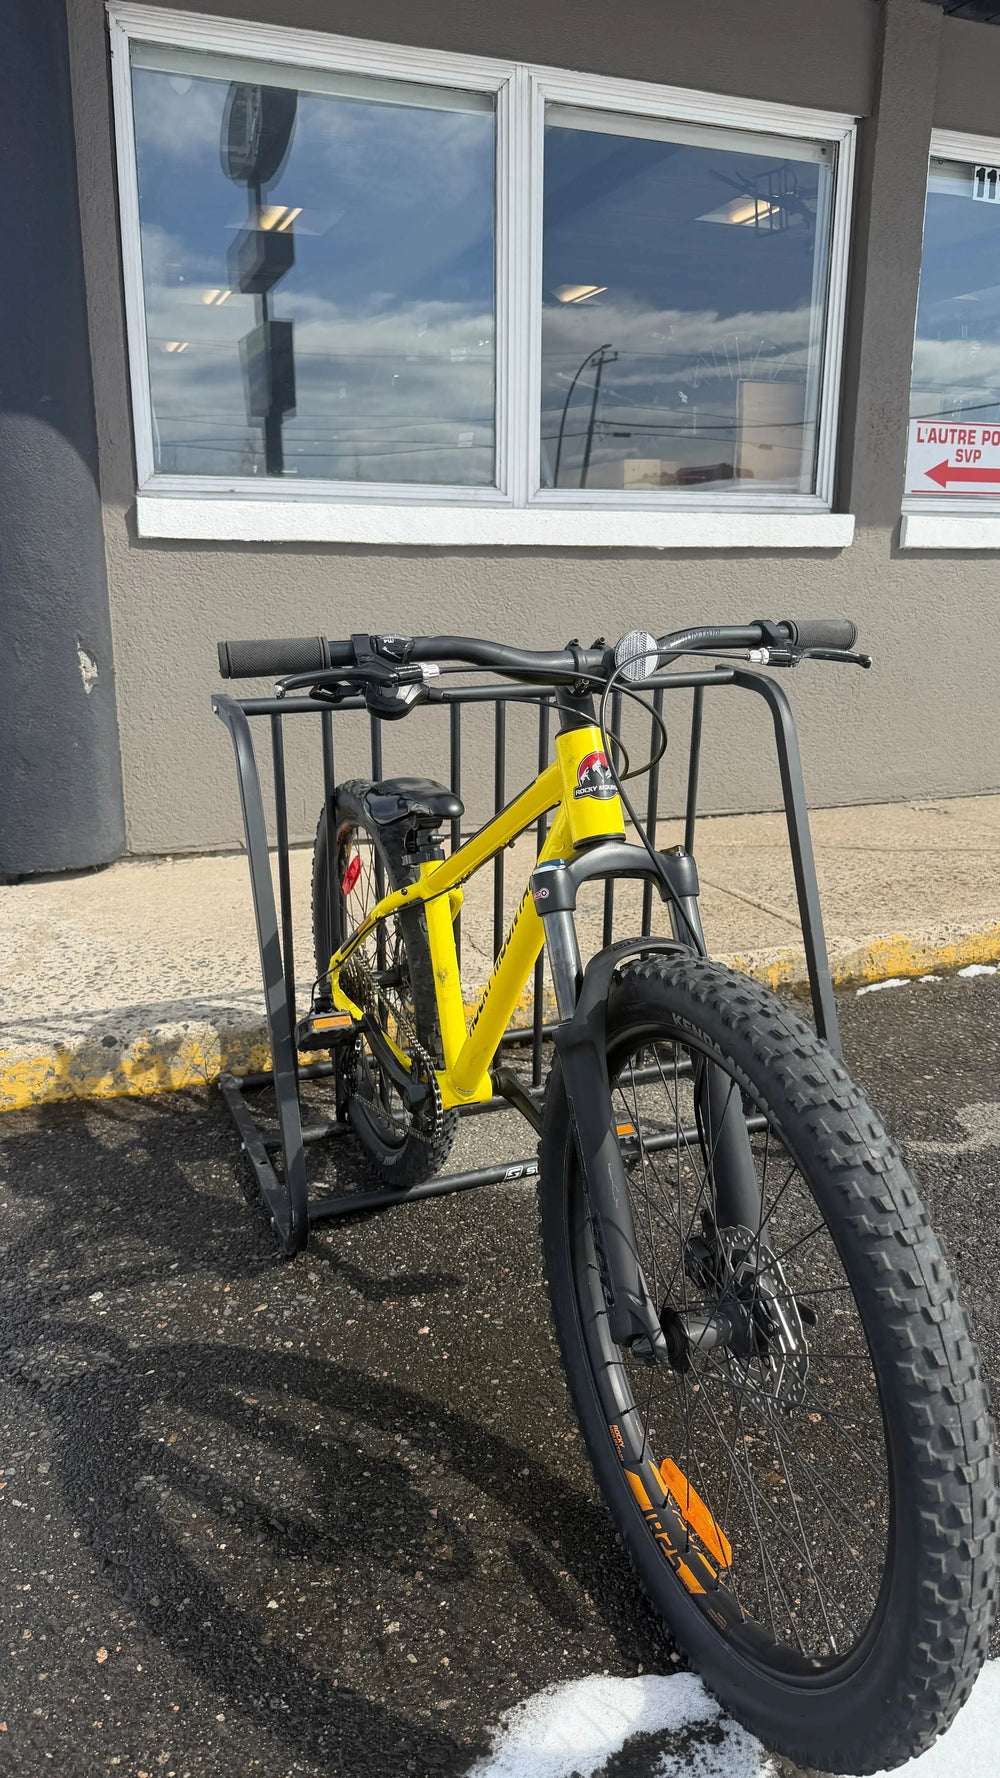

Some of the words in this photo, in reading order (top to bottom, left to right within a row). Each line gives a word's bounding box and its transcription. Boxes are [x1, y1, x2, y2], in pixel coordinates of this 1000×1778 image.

[916, 426, 976, 446] L'AUTRE
[955, 448, 982, 463] SVP
[575, 785, 598, 796] ROCKY
